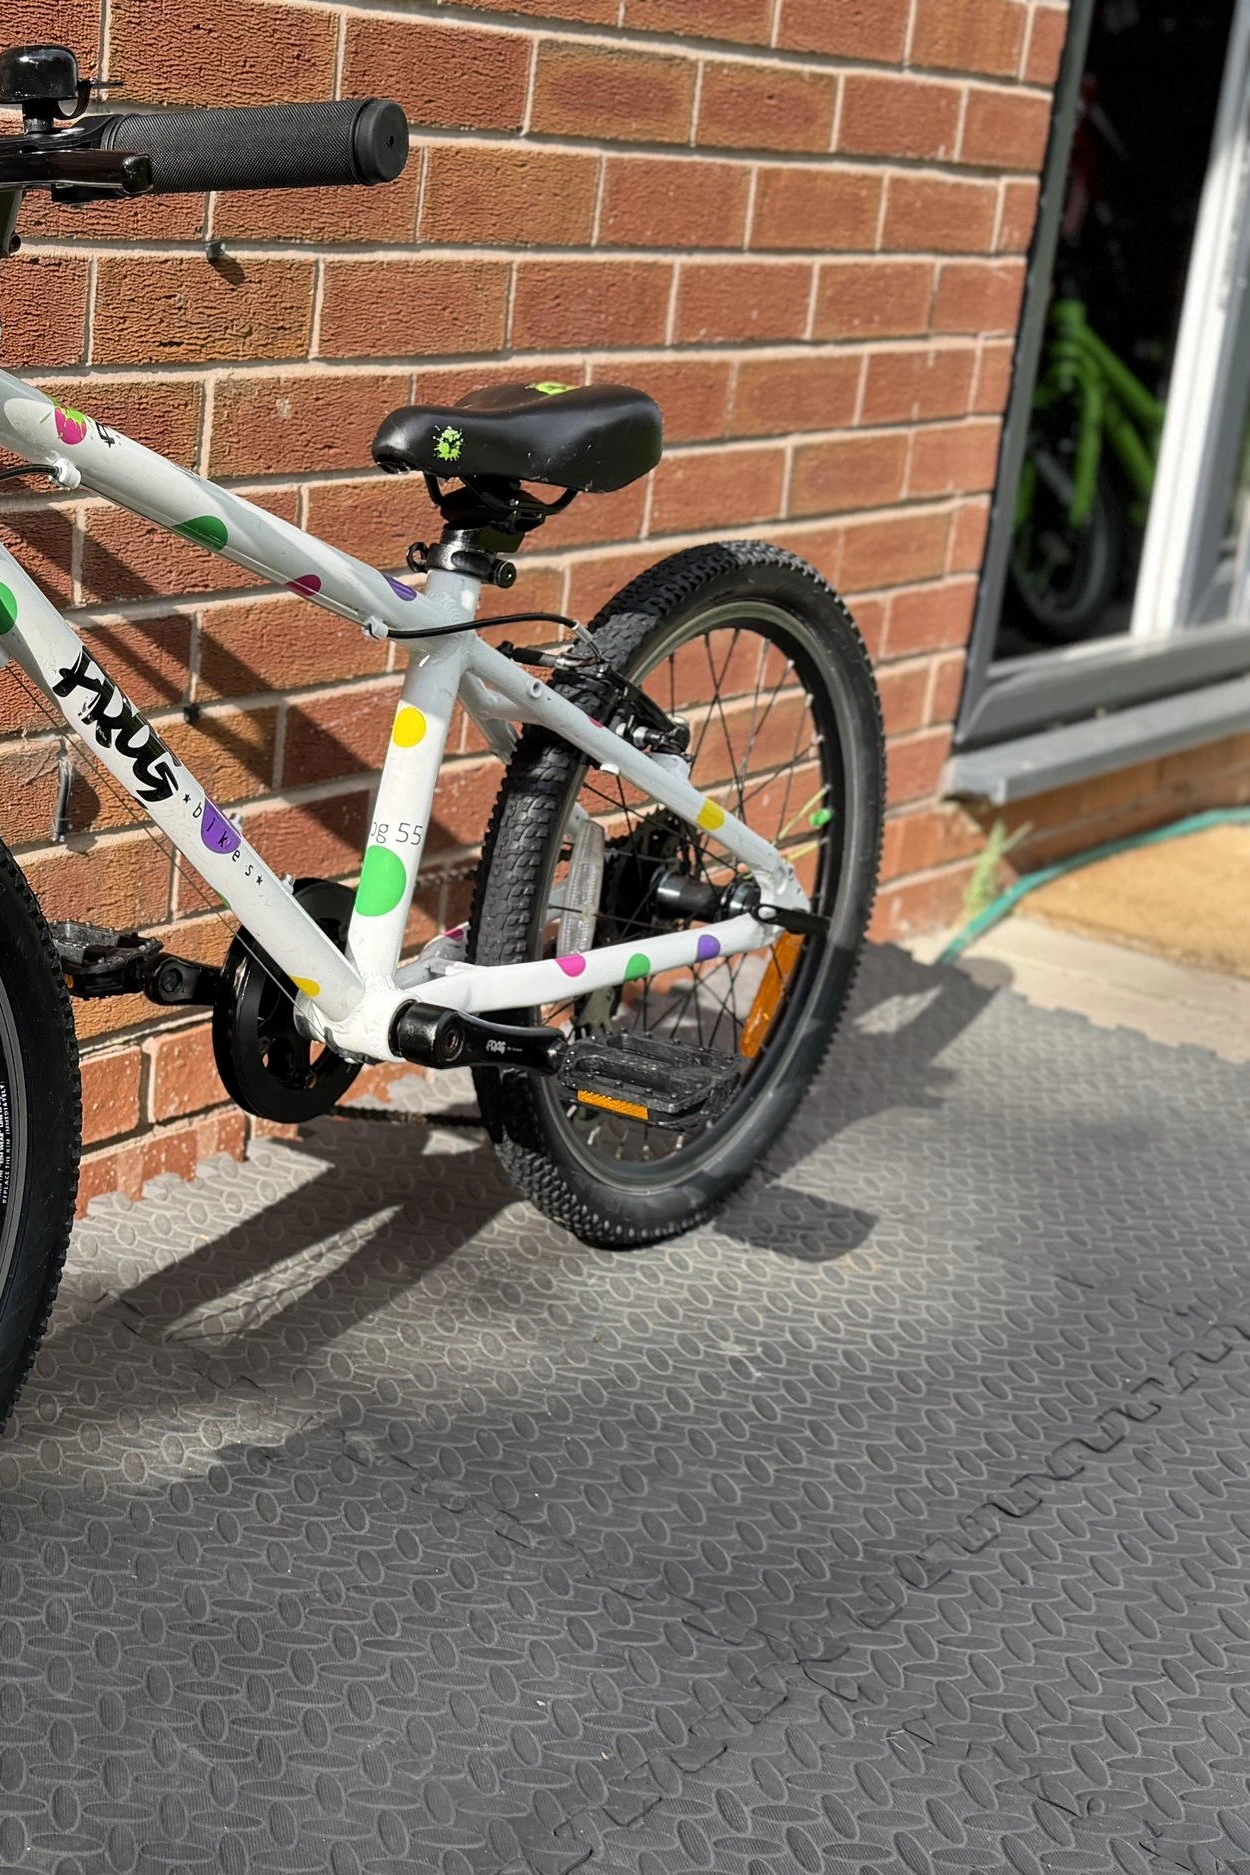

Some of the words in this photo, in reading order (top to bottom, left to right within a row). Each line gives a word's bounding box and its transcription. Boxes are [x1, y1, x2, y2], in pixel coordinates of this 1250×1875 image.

[192, 802, 254, 877] bikes
[395, 822, 424, 846] 55
[2, 1171, 10, 1204] REPLACE
